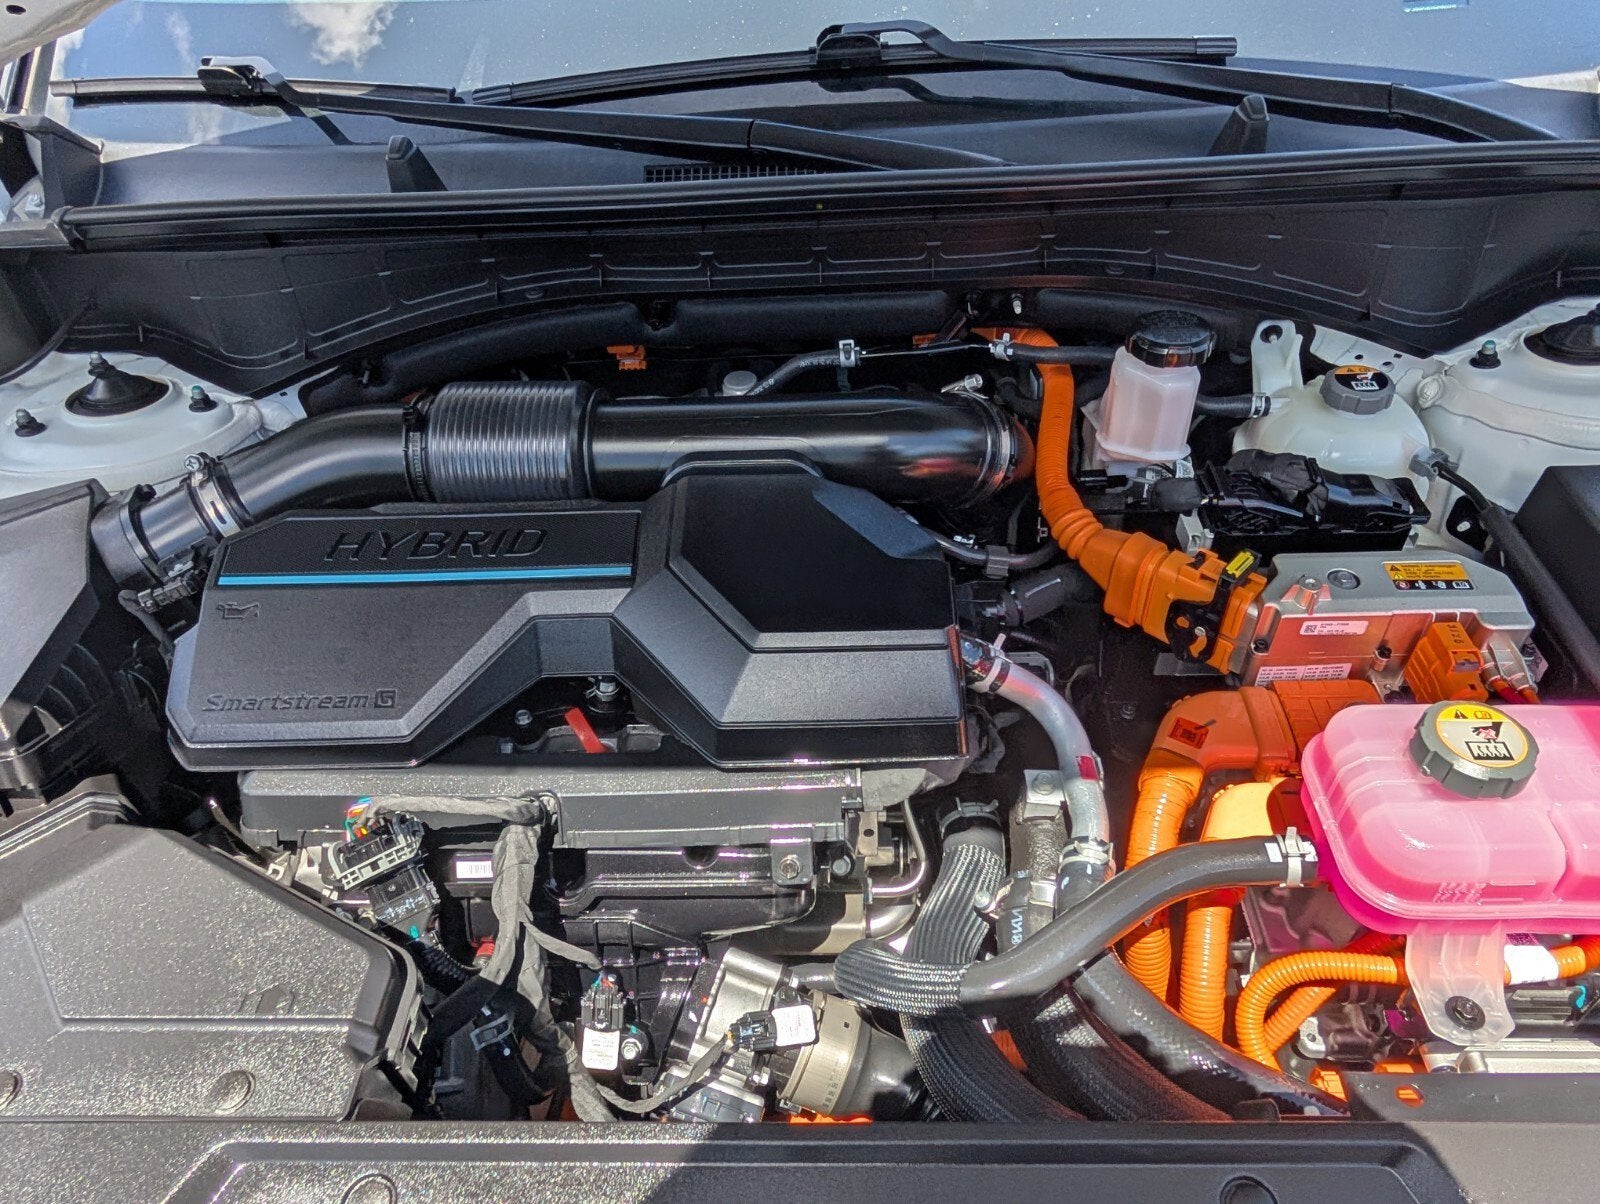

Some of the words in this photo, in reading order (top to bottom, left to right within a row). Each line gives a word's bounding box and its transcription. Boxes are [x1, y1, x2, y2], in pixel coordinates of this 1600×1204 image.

[324, 529, 548, 561] HYBRID
[202, 692, 370, 712] Smartstream
[373, 688, 398, 709] G
